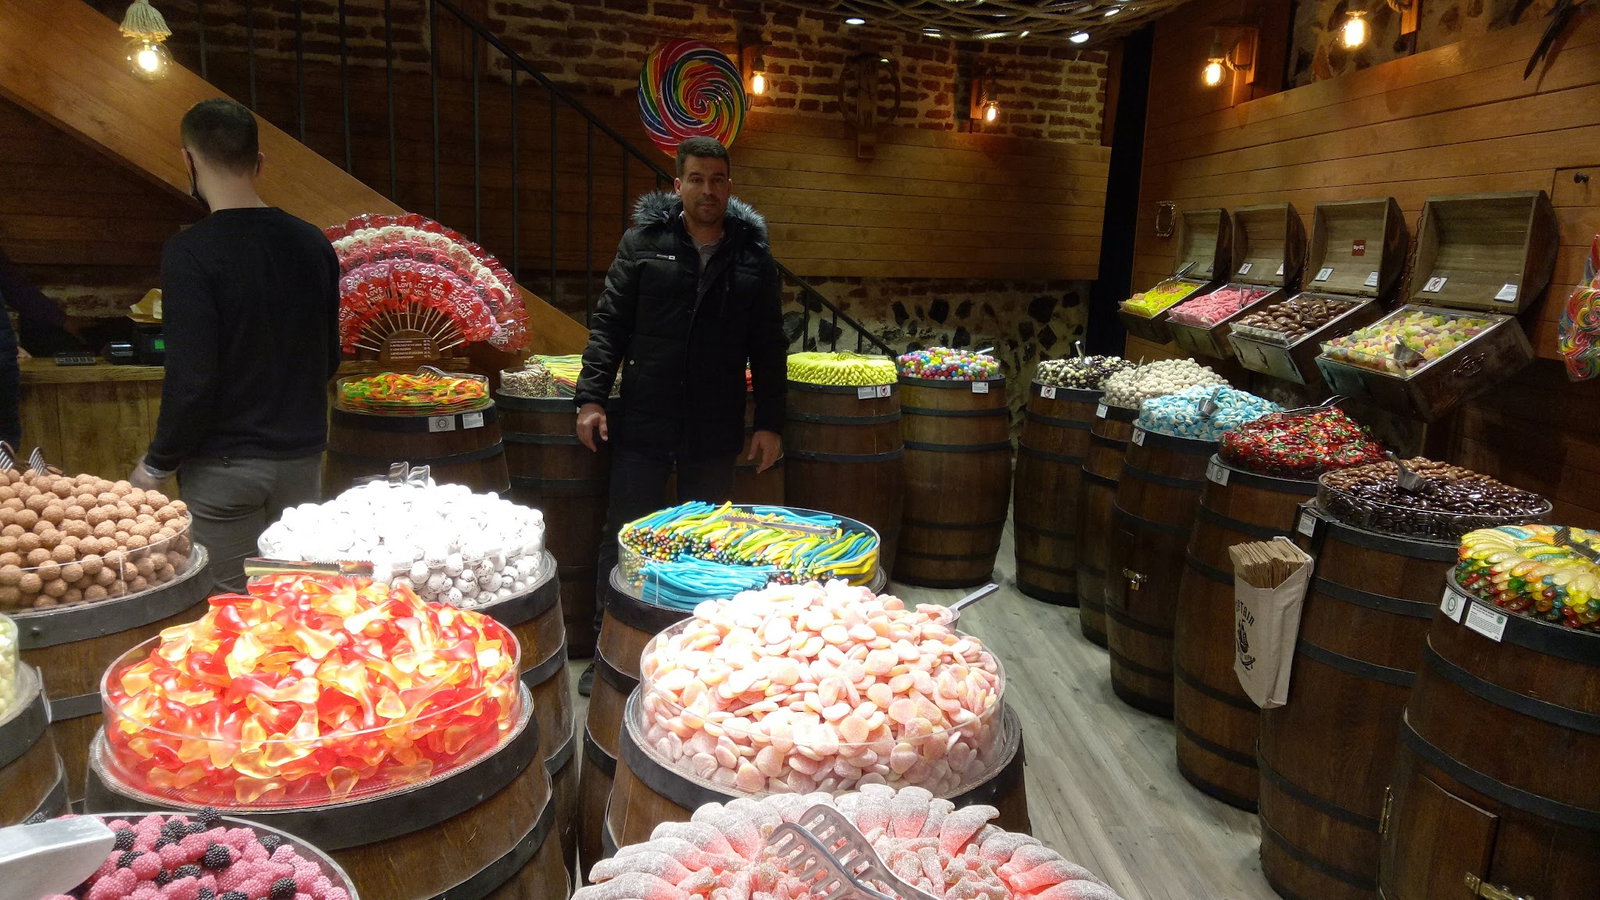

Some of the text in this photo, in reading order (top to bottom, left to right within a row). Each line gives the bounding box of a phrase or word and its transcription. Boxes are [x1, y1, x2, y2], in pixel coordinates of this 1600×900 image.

[365, 287, 384, 298] LOVE
[429, 285, 445, 296] LOVE
[456, 300, 474, 317] LOVE
[456, 306, 467, 318] YOU
